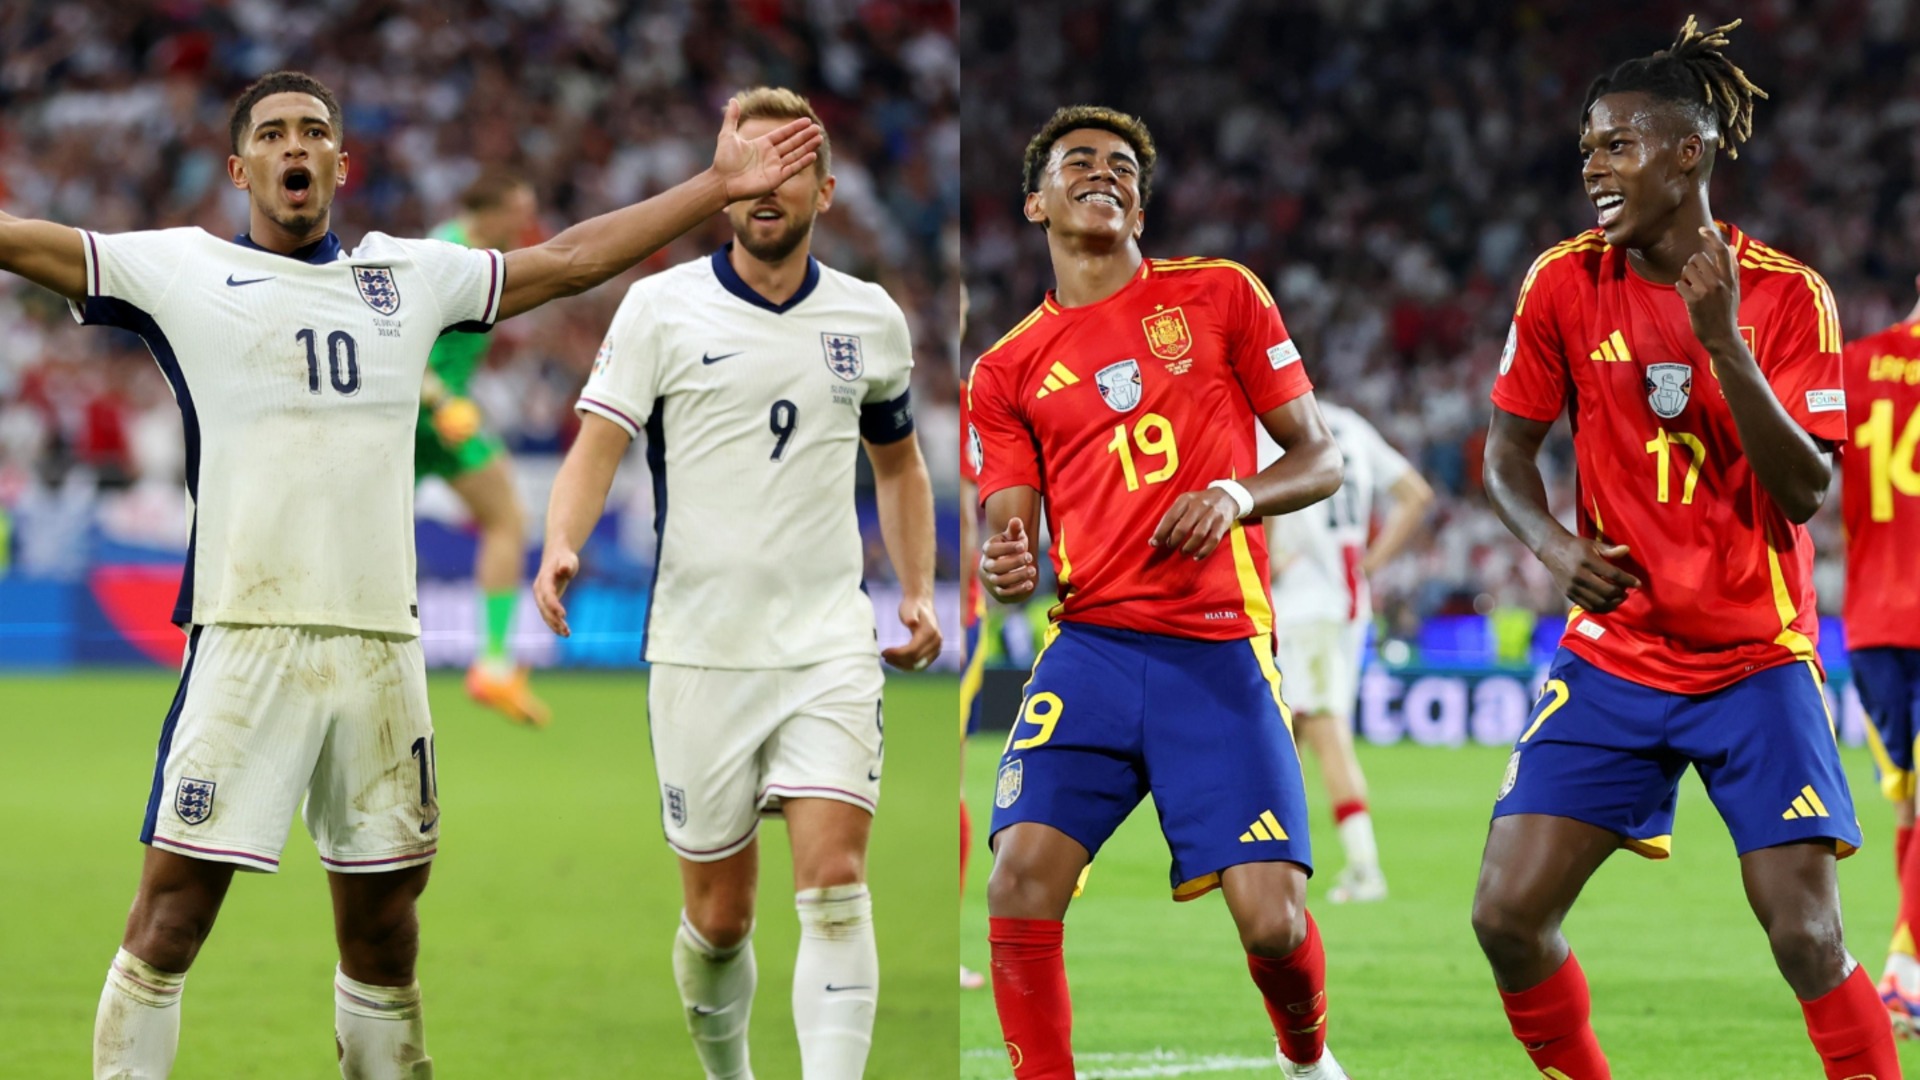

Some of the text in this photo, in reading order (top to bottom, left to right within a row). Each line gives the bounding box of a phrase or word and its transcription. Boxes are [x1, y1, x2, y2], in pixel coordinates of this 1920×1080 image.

[295, 328, 362, 397] 10
[769, 399, 800, 463] 9
[1107, 412, 1179, 493] 19
[1646, 427, 1706, 505] 17
[411, 734, 437, 807] 1
